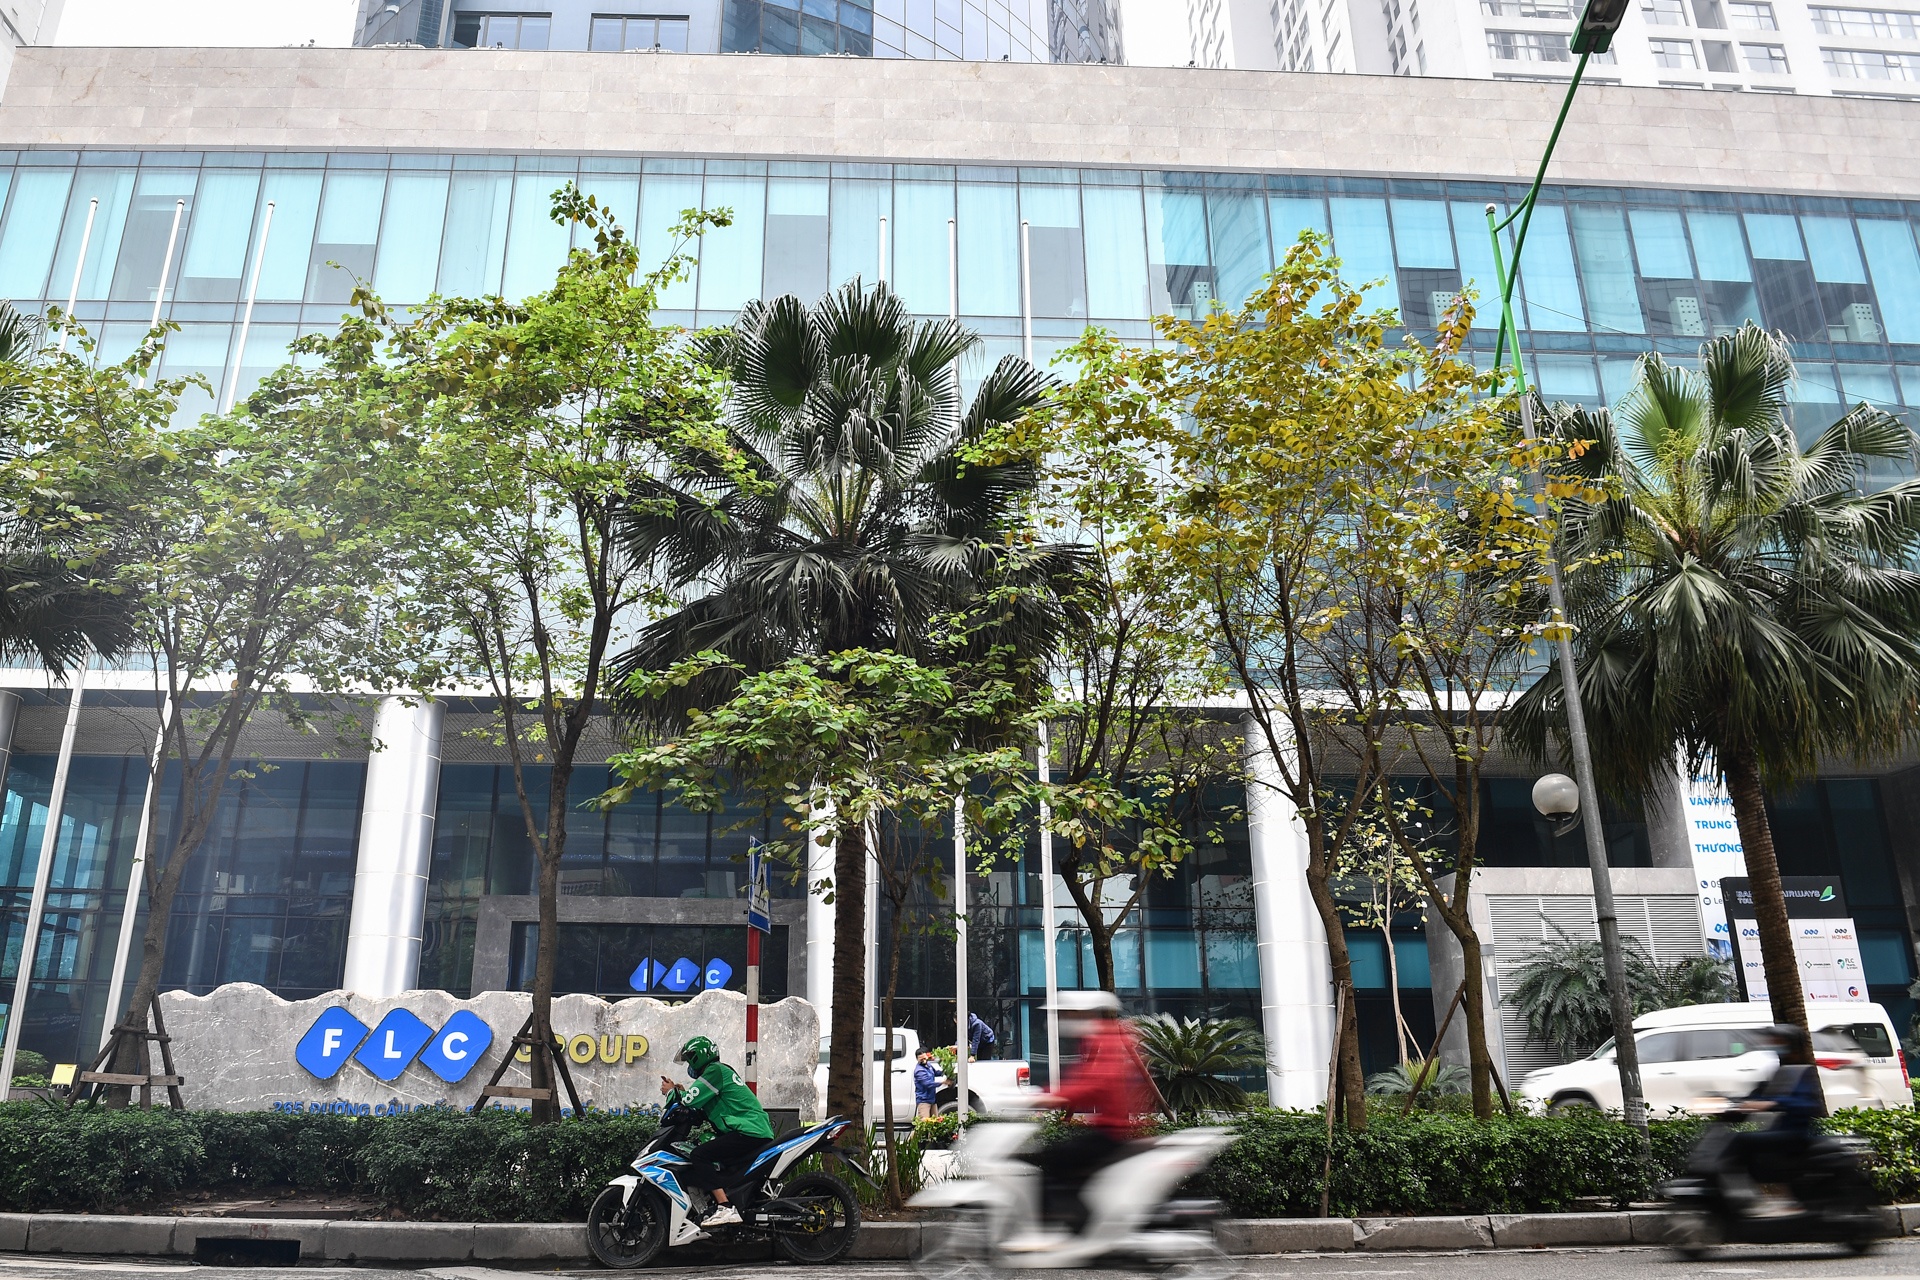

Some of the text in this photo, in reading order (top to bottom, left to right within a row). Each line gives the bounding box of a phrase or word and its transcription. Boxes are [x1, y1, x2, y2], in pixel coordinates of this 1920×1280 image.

[1695, 821, 1732, 829] TRUNG
[1695, 843, 1742, 852] THƯƠNG
[273, 1101, 303, 1115] 265
